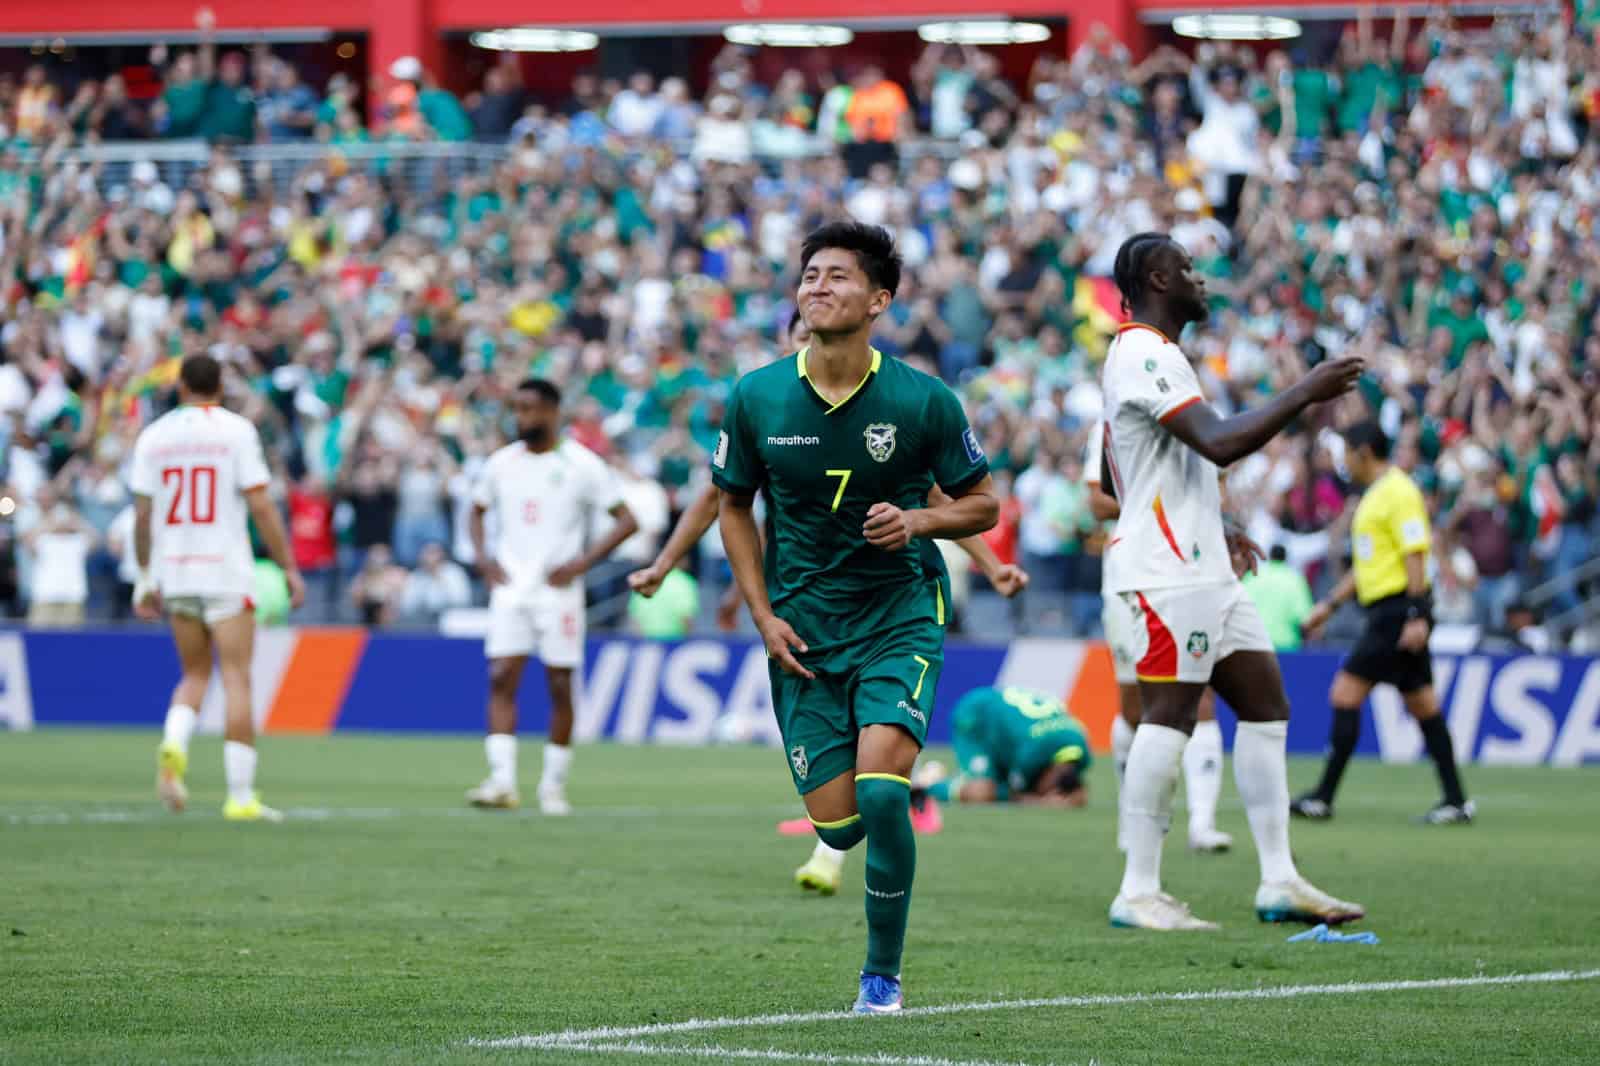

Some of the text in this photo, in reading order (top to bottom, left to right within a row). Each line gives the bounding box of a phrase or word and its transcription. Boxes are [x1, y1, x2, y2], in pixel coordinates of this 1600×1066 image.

[767, 435, 820, 446] marathon
[162, 466, 216, 524] 20
[825, 469, 852, 512] 7
[912, 654, 930, 700] 7
